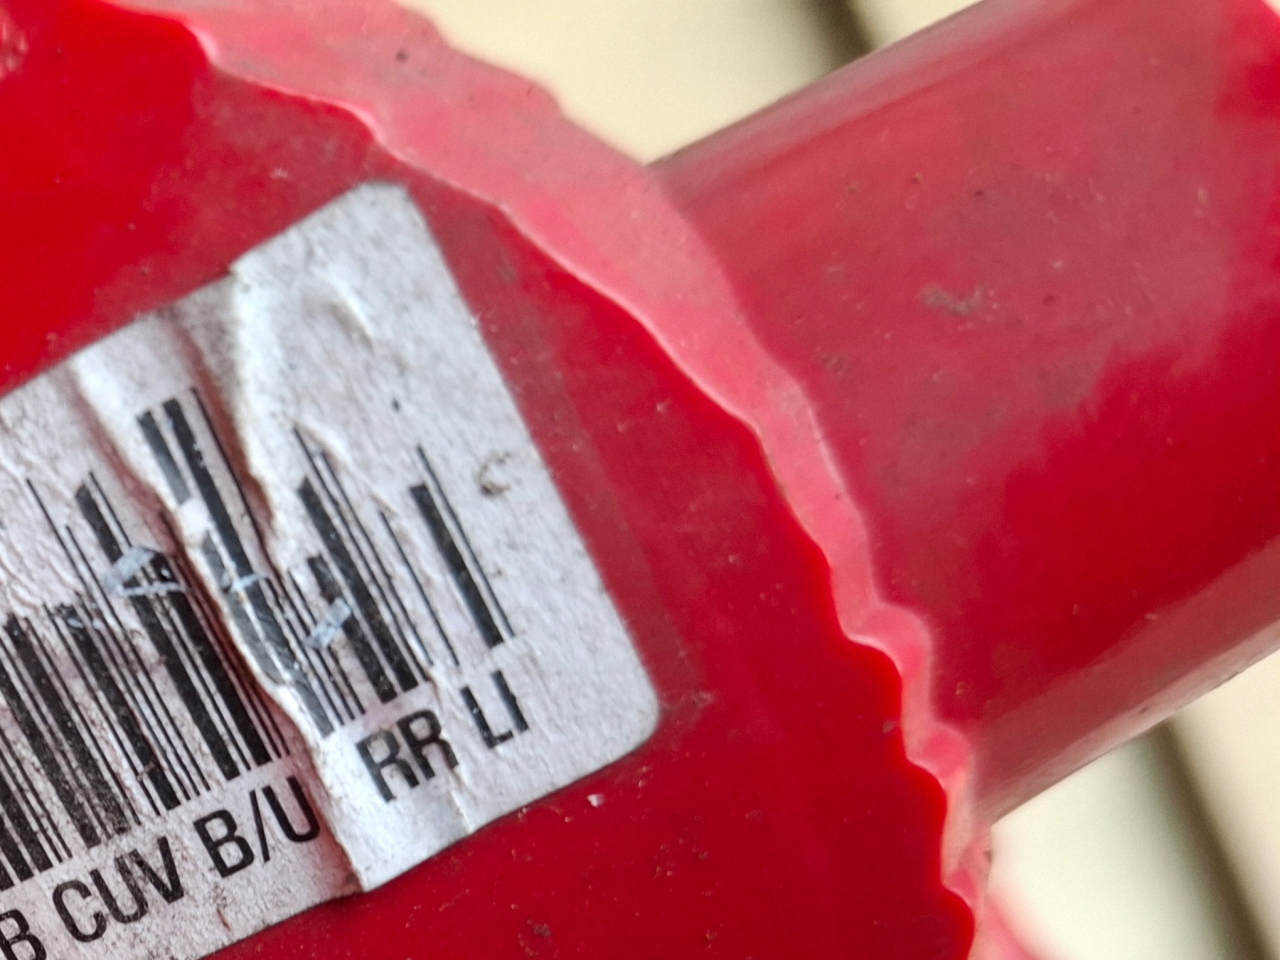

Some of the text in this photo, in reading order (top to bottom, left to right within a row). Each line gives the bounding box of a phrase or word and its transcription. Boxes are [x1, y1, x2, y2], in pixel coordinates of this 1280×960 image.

[52, 836, 185, 944] CUV
[192, 775, 320, 878] B/U
[355, 709, 460, 803] RR
[460, 669, 530, 749] LI
